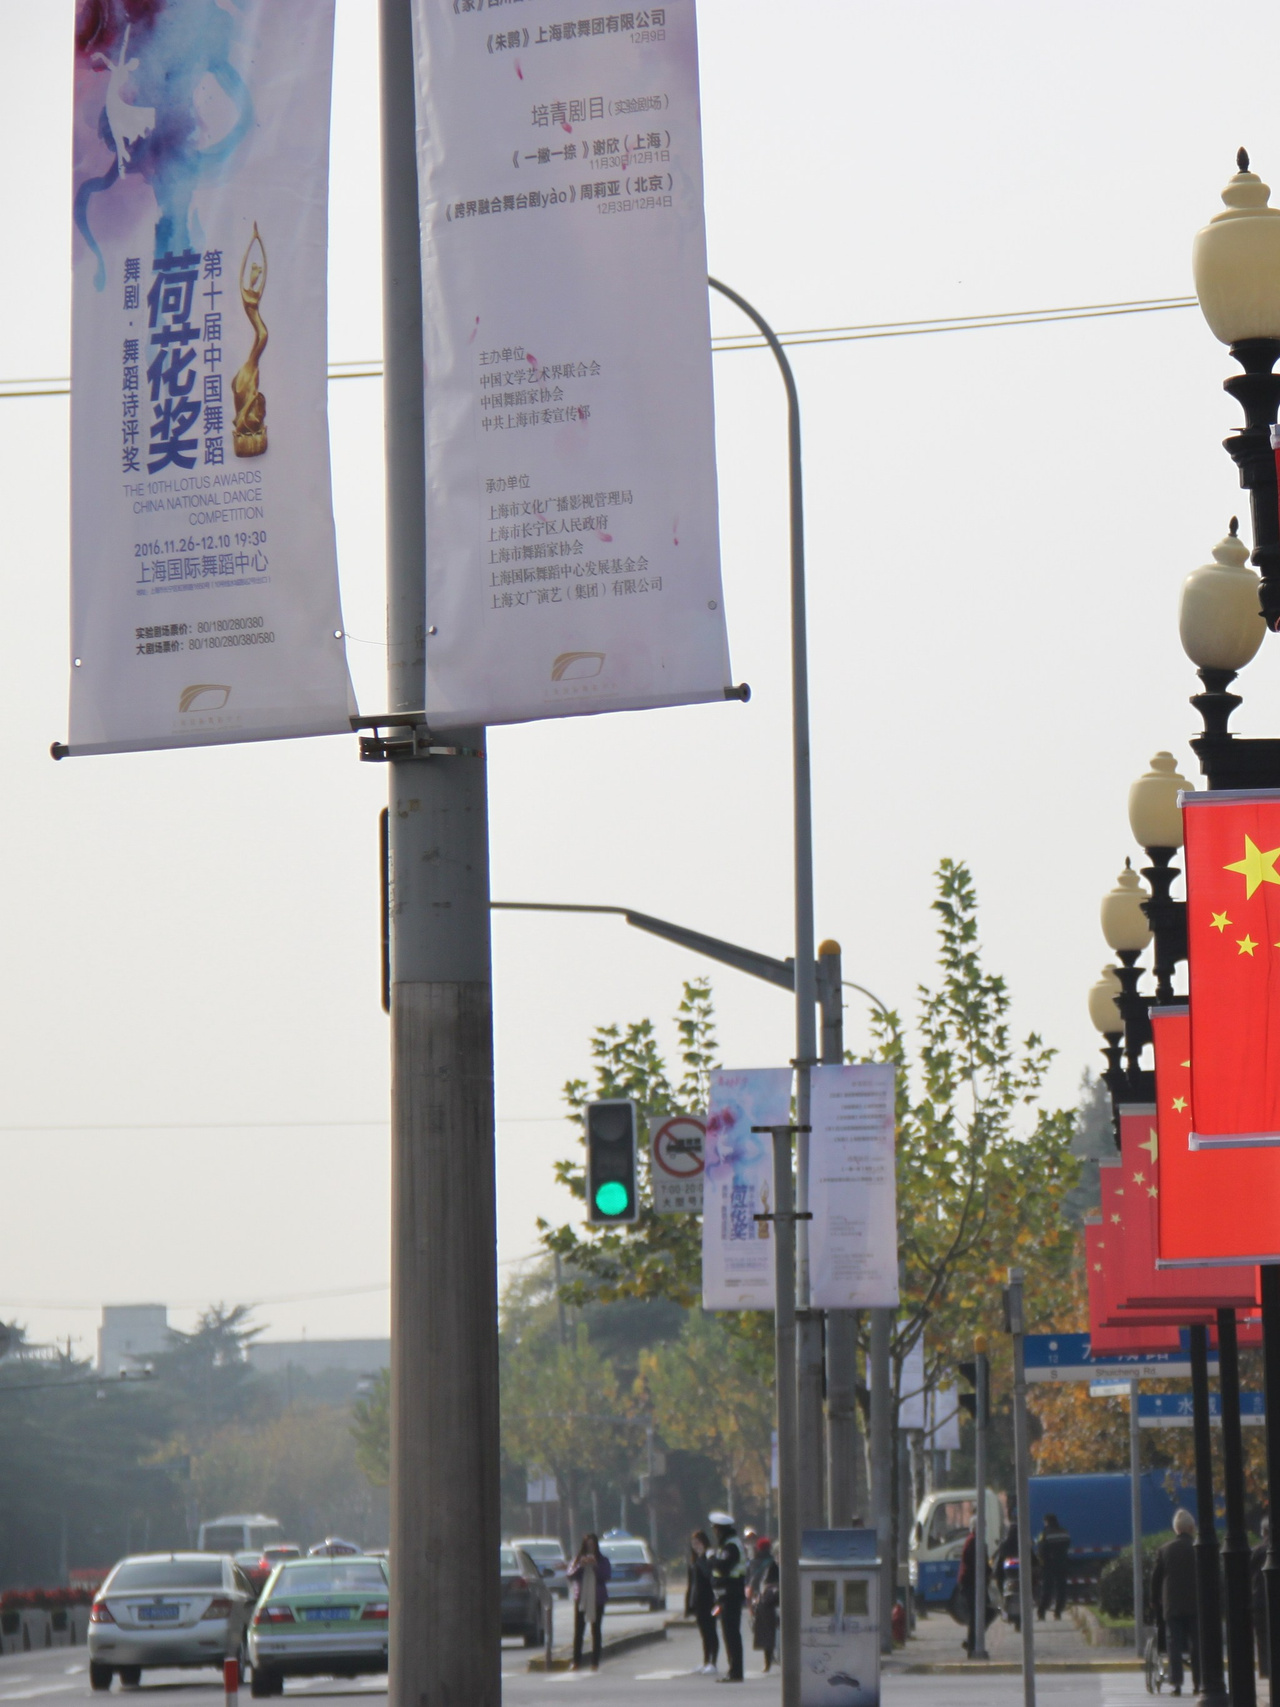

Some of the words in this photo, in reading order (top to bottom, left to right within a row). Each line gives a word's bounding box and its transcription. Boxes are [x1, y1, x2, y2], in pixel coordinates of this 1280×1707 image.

[147, 249, 202, 475] 荷花奖
[203, 249, 224, 466] 第十届中国舞蹈
[479, 346, 525, 366] 主办单位
[480, 360, 601, 389] 中国文学艺术界联合会
[480, 386, 564, 410] 中国舞蹈家协会
[482, 405, 591, 431] 中共上海市委宣传部
[123, 484, 144, 497] THE
[147, 479, 172, 495] 10TH
[174, 476, 210, 492] LOTUS
[213, 471, 262, 487] AWARDS
[486, 474, 530, 494] 承办单位
[133, 500, 165, 514] CHINA
[167, 495, 221, 511] NATIONAL
[224, 488, 262, 505] DANCE
[488, 490, 633, 521] 上海市文化广播影视管理局
[189, 506, 264, 526] COMPETITION
[487, 514, 609, 542] 上海市长宁区人民政府
[135, 534, 230, 557] 2016.11.26-12.10
[235, 530, 267, 547] 19:30
[488, 539, 584, 565] 上海市舞蹈家协会
[136, 550, 269, 584] 上海国际舞蹈中心
[489, 555, 649, 587] 上海国际舞蹈中心发展基金会
